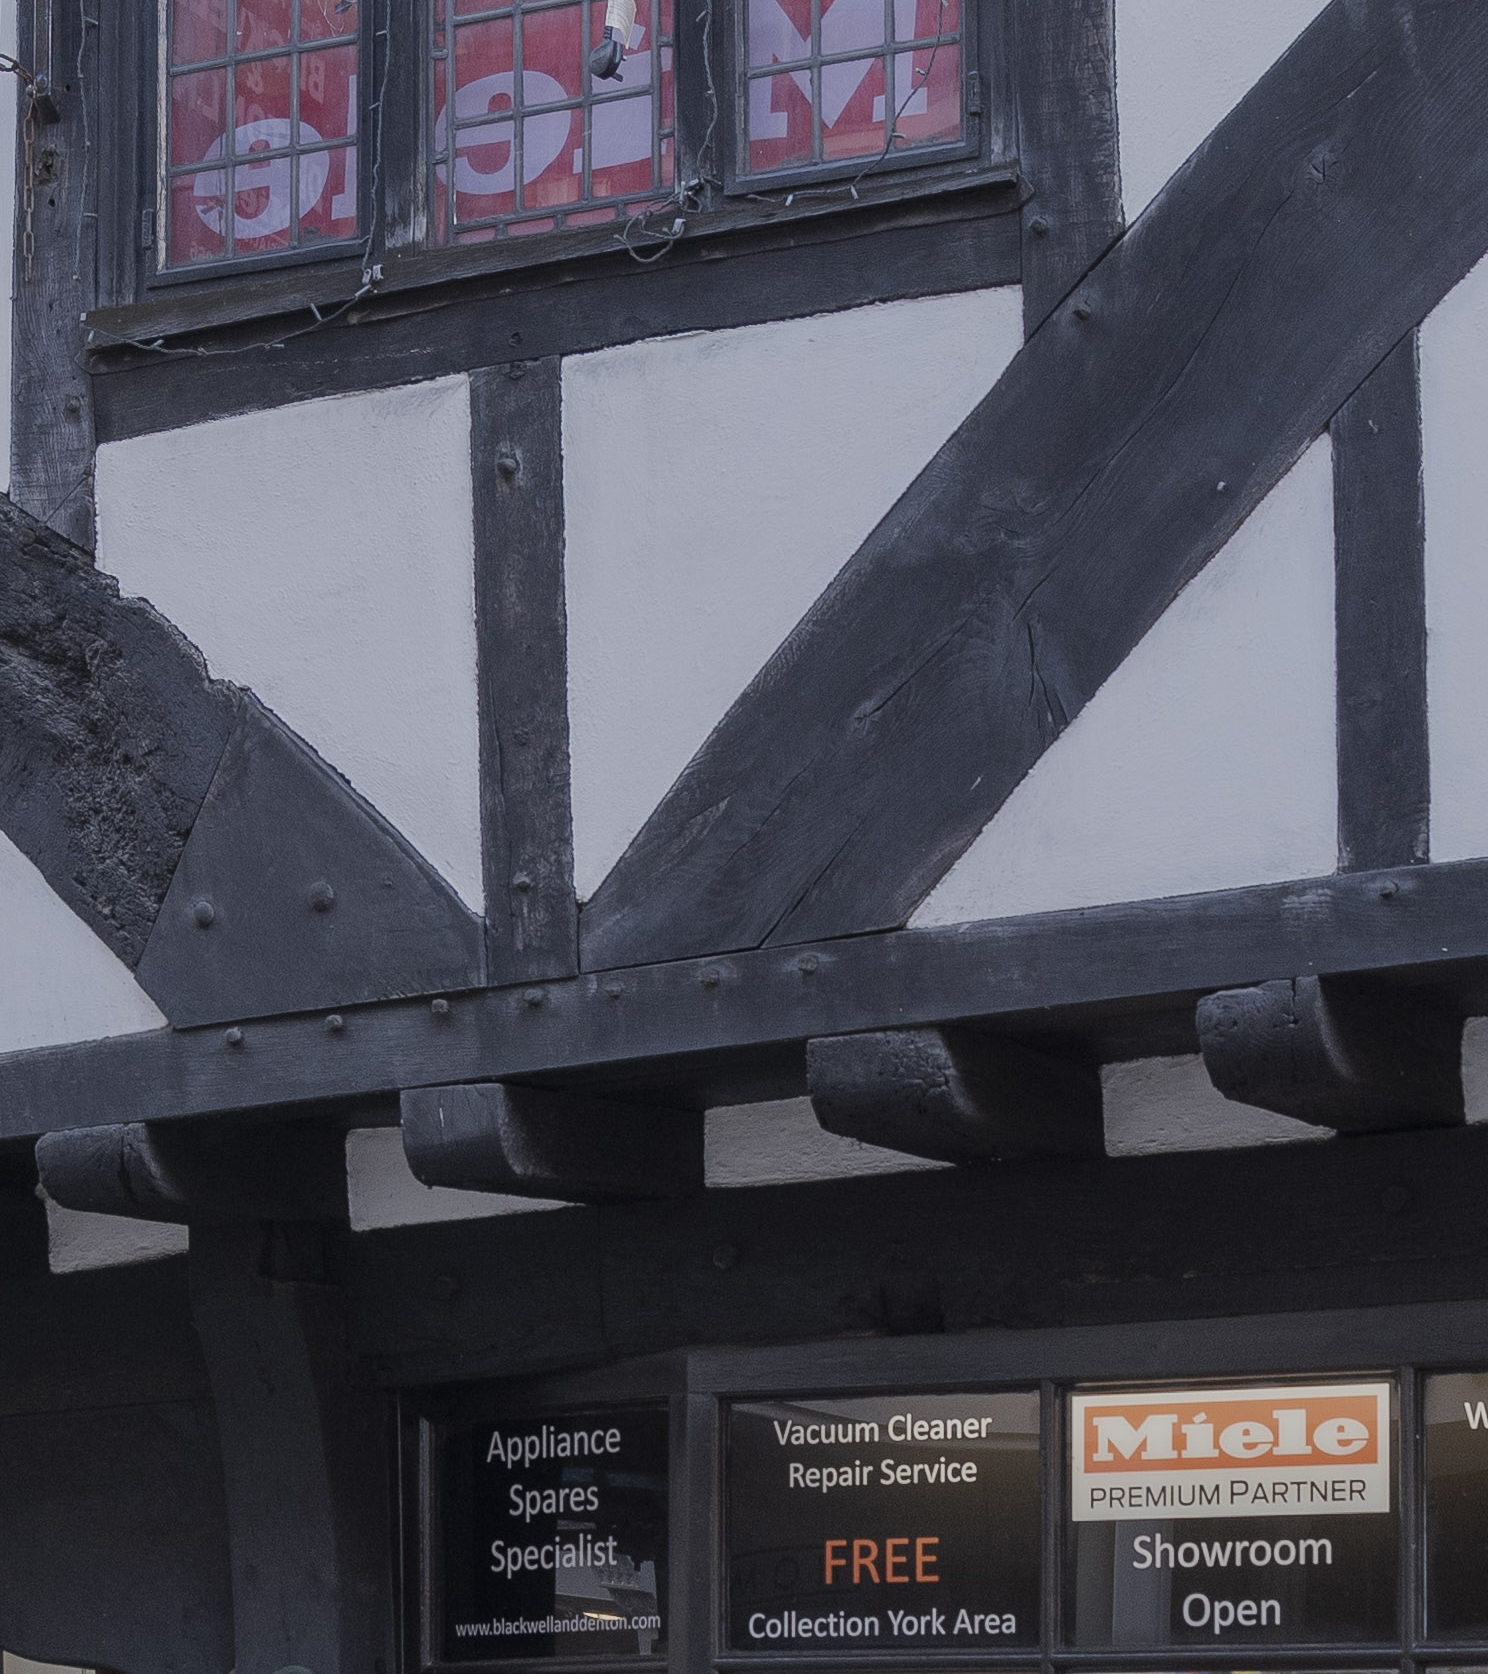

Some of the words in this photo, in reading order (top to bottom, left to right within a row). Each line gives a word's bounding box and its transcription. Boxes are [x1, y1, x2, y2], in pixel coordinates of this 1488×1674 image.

[487, 1425, 622, 1467] Appliance
[774, 1417, 879, 1446] Vacuum
[887, 1413, 992, 1443] Cleaner
[1091, 1408, 1370, 1462] Miele
[789, 1461, 873, 1492] Repair
[879, 1457, 978, 1486] Service
[508, 1483, 599, 1522] Spares
[1089, 1481, 1221, 1511] PREMIUM
[1228, 1479, 1367, 1503] PARTNER
[491, 1534, 618, 1579] Specialist
[824, 1536, 940, 1585] FREE
[1131, 1532, 1334, 1570] Showroom
[455, 1611, 661, 1639] www.blackwellanddenton.com
[748, 1613, 878, 1640] Collection
[887, 1608, 946, 1636] York
[953, 1608, 1017, 1636] Area
[1181, 1592, 1282, 1632] Open
